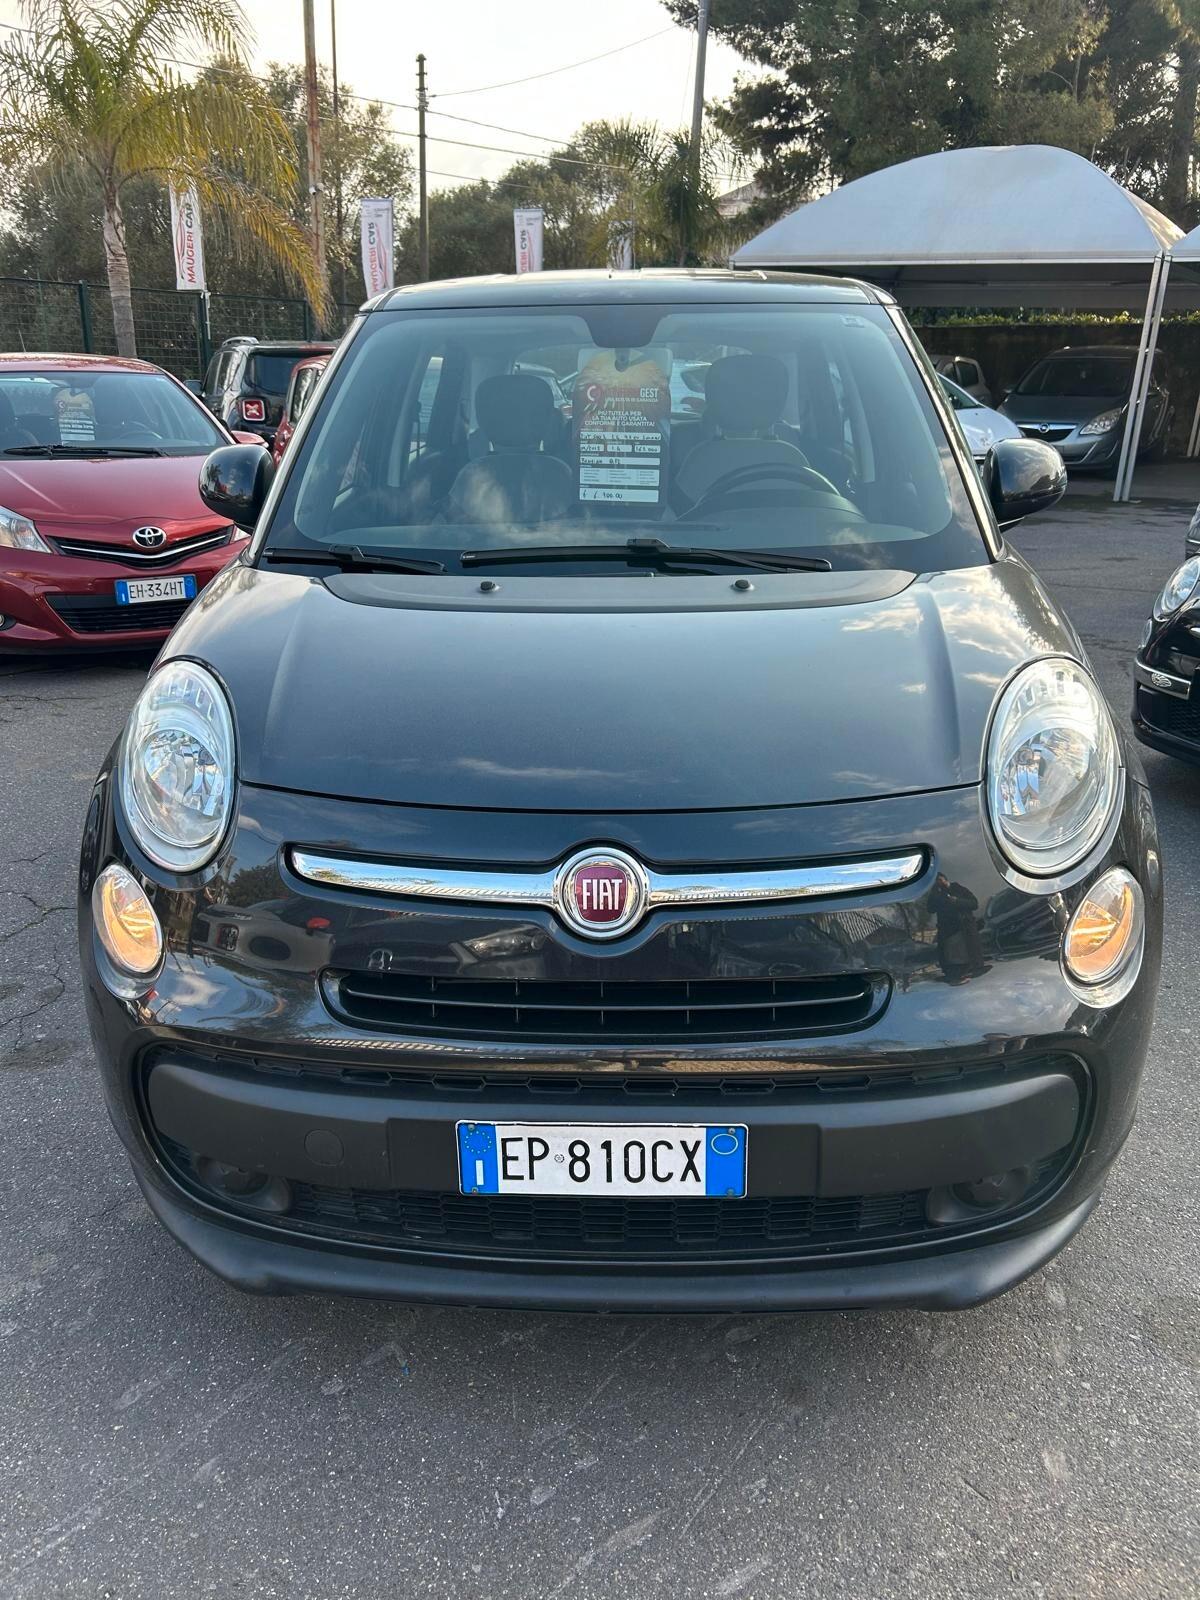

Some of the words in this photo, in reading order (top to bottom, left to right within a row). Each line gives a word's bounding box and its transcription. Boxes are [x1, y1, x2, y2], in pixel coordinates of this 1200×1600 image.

[186, 231, 196, 284] MAUGERI
[640, 388, 659, 397] GEST
[582, 878, 623, 911] FIAT
